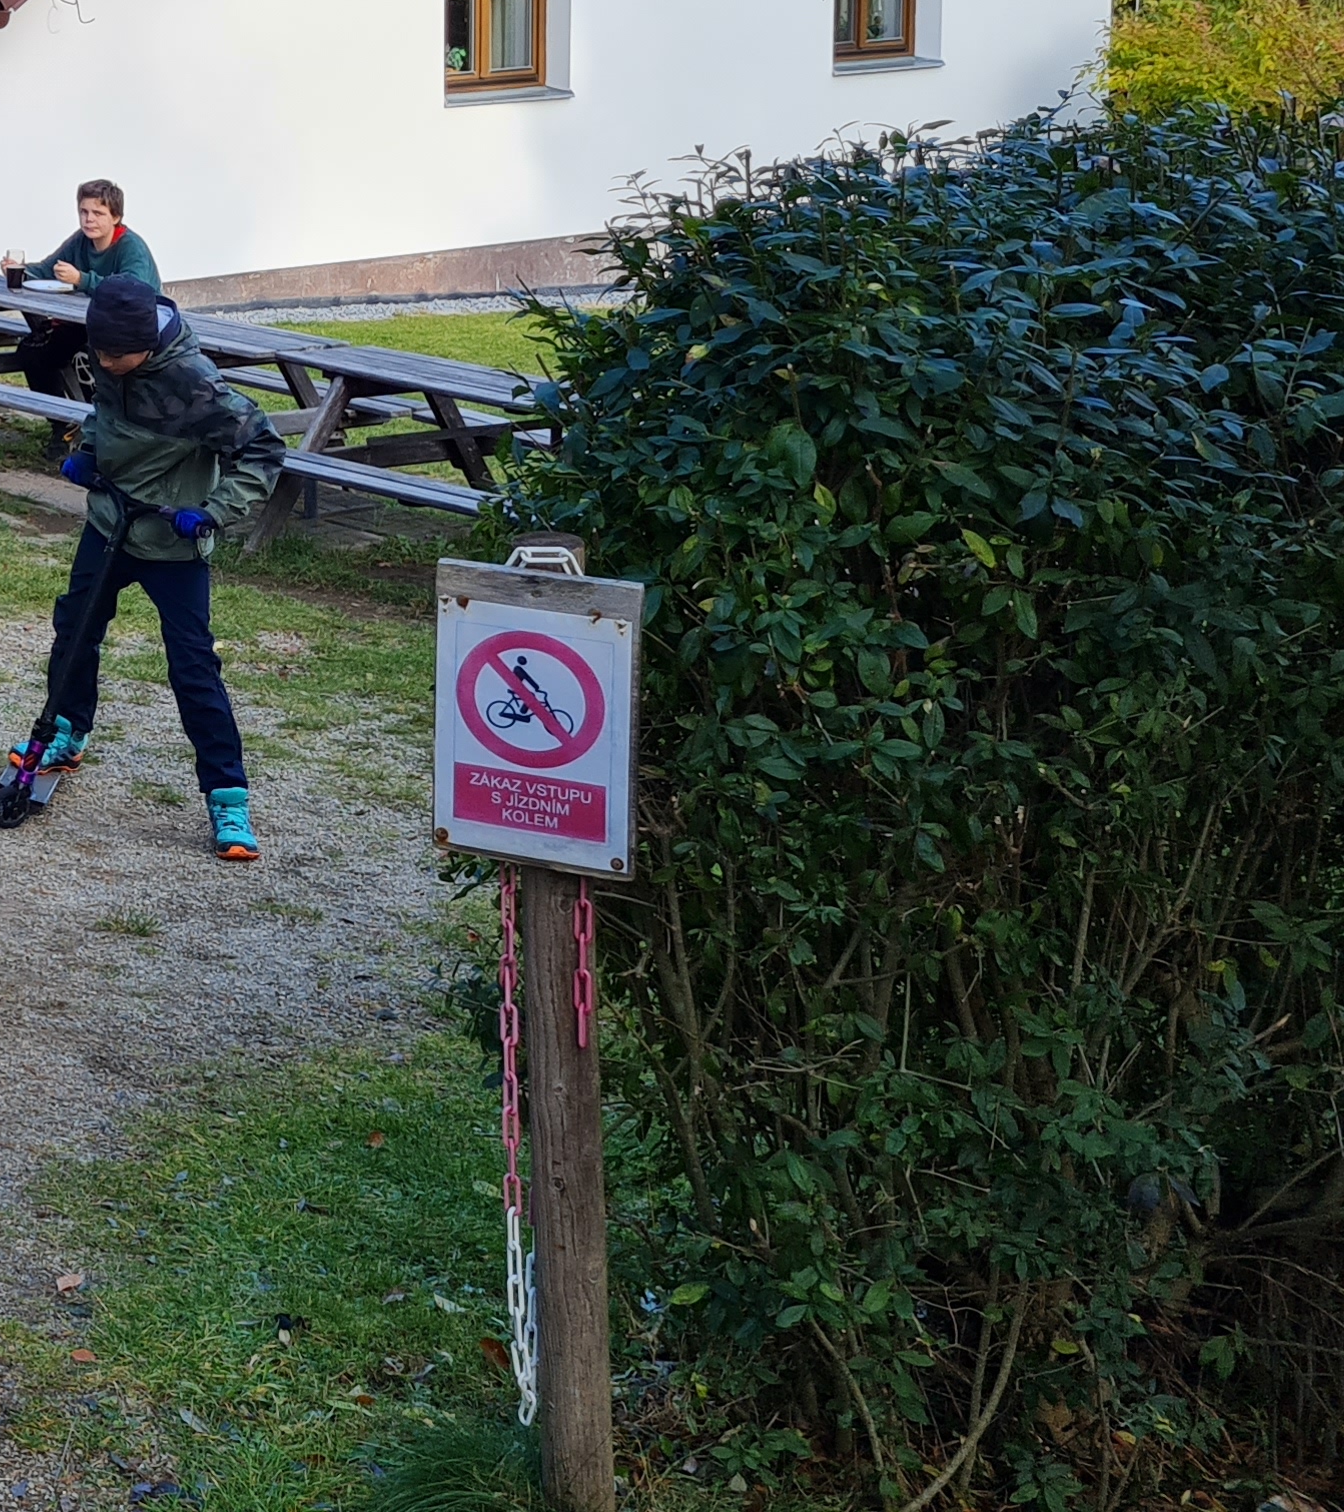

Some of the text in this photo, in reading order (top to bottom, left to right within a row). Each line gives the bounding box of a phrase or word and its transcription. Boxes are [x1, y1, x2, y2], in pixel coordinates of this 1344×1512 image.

[469, 771, 592, 804] ZÁKAZ VSTUPU
[491, 791, 570, 816] S JÍZDNÍM
[501, 808, 559, 829] KOLEM
